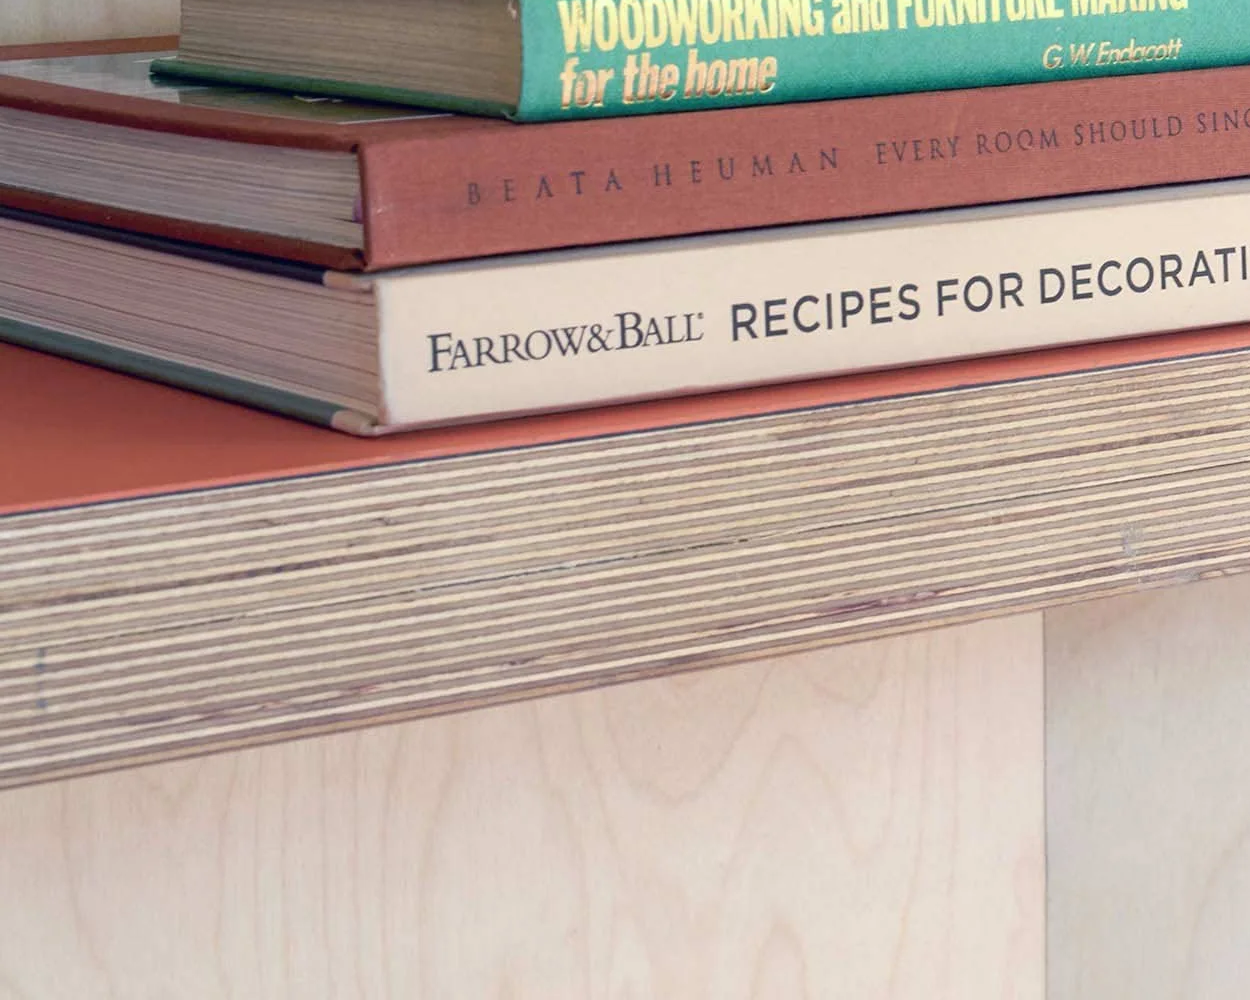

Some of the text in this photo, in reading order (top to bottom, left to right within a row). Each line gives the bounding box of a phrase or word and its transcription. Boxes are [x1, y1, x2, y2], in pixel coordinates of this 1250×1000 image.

[560, 48, 778, 110] for the home
[1095, 37, 1183, 66] Endacott
[875, 135, 960, 165] EVERY
[976, 127, 1060, 155] ROOM
[1073, 115, 1183, 147] SHOULD
[467, 147, 839, 206] BEATA HEUMAN
[731, 283, 921, 341] RECIPES
[936, 272, 1025, 317] FOR
